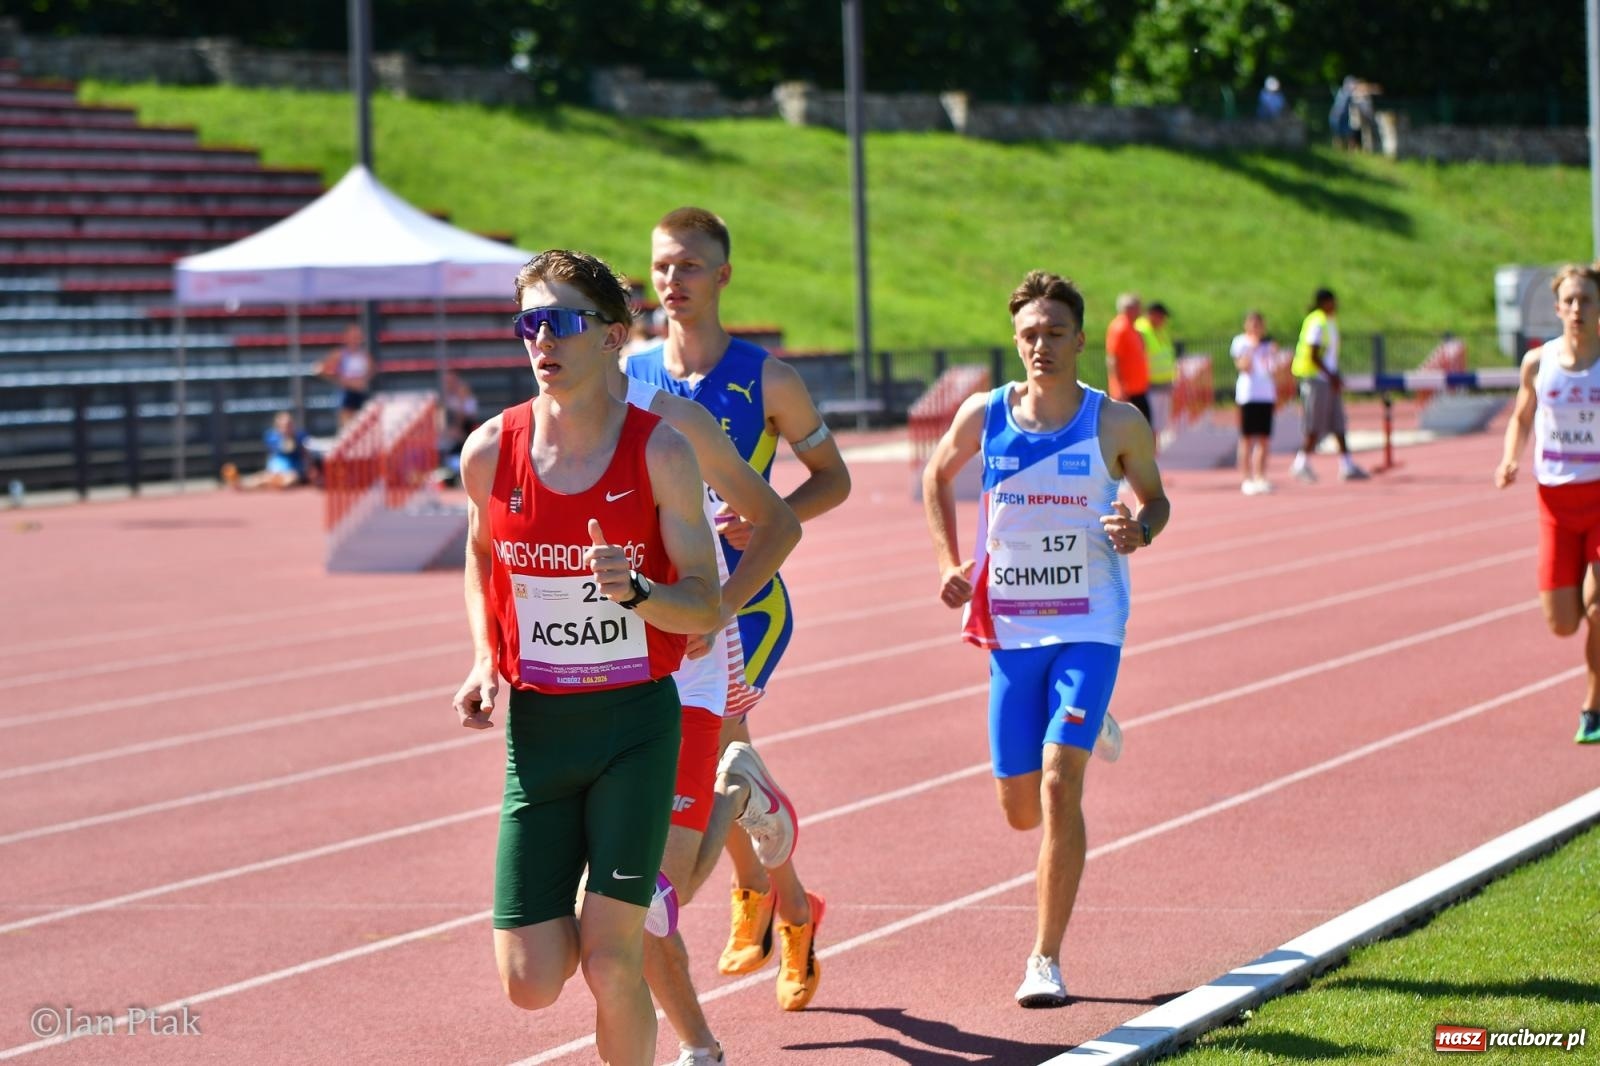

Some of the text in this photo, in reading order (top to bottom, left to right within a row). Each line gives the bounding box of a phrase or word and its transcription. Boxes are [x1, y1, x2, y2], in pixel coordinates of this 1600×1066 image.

[1028, 494, 1088, 507] REPUBLIC
[1041, 534, 1077, 552] 157
[994, 564, 1083, 586] SCHMIDT
[582, 582, 609, 602] 2
[531, 615, 628, 647] ACSÁDI
